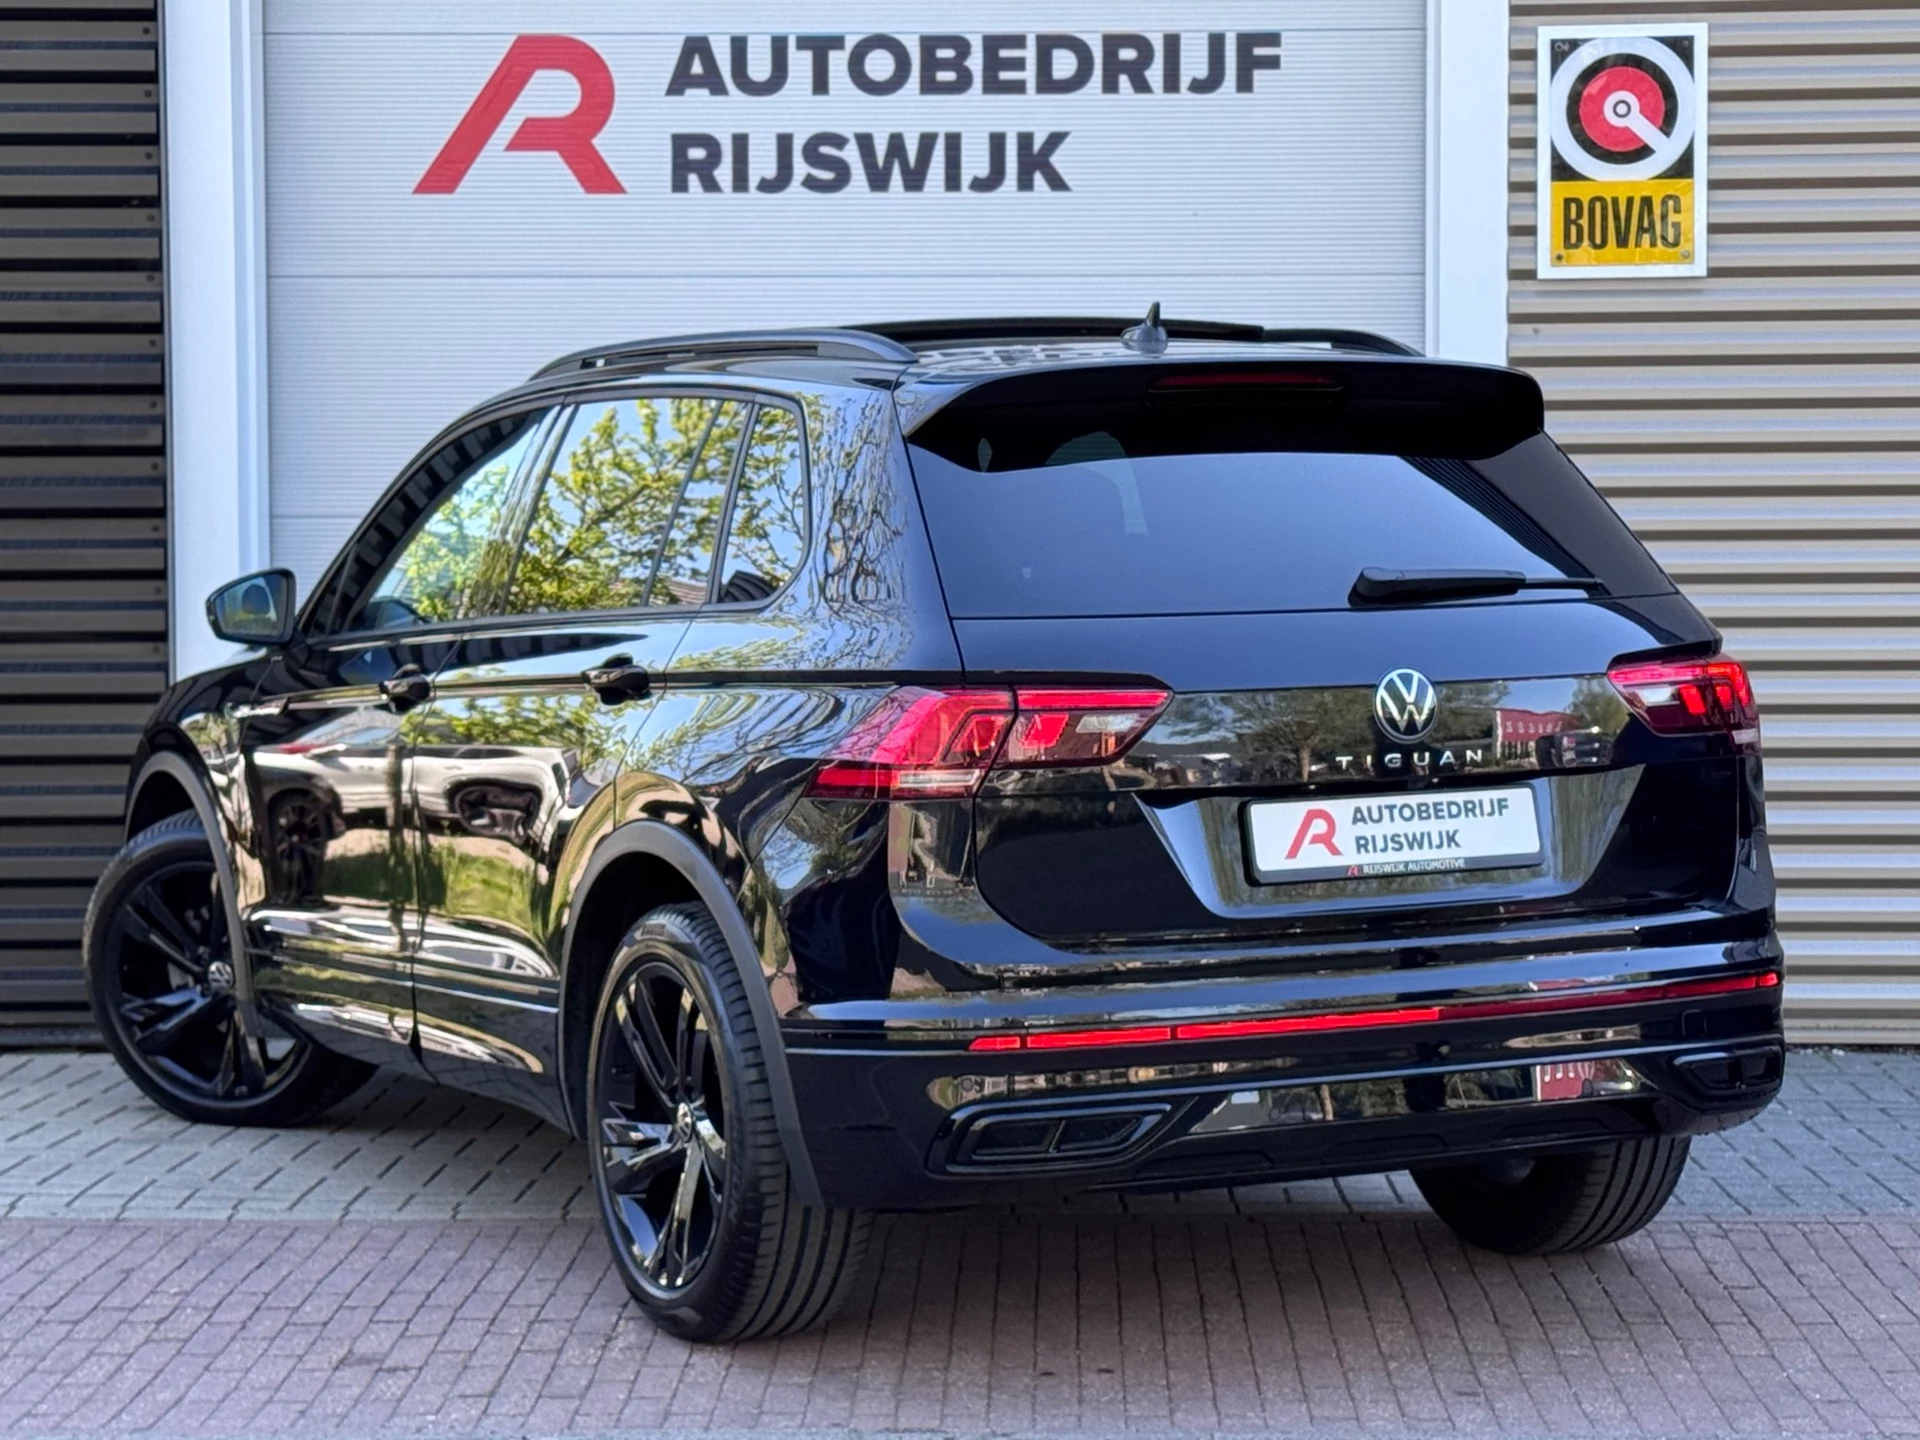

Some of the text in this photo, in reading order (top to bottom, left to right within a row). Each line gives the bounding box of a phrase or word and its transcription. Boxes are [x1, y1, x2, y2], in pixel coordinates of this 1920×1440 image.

[665, 32, 1282, 96] AUTOBEDRIJF
[670, 131, 1073, 194] RIJSWIJK
[1563, 194, 1682, 250] BOVAG
[1335, 749, 1482, 770] TIGUAN
[1351, 797, 1509, 825] AUTOBEDRIJF
[1354, 829, 1461, 854] RIJSWIJK
[1362, 861, 1406, 875] RIJSWIJK
[1408, 858, 1466, 872] AUTOMOTIVE
